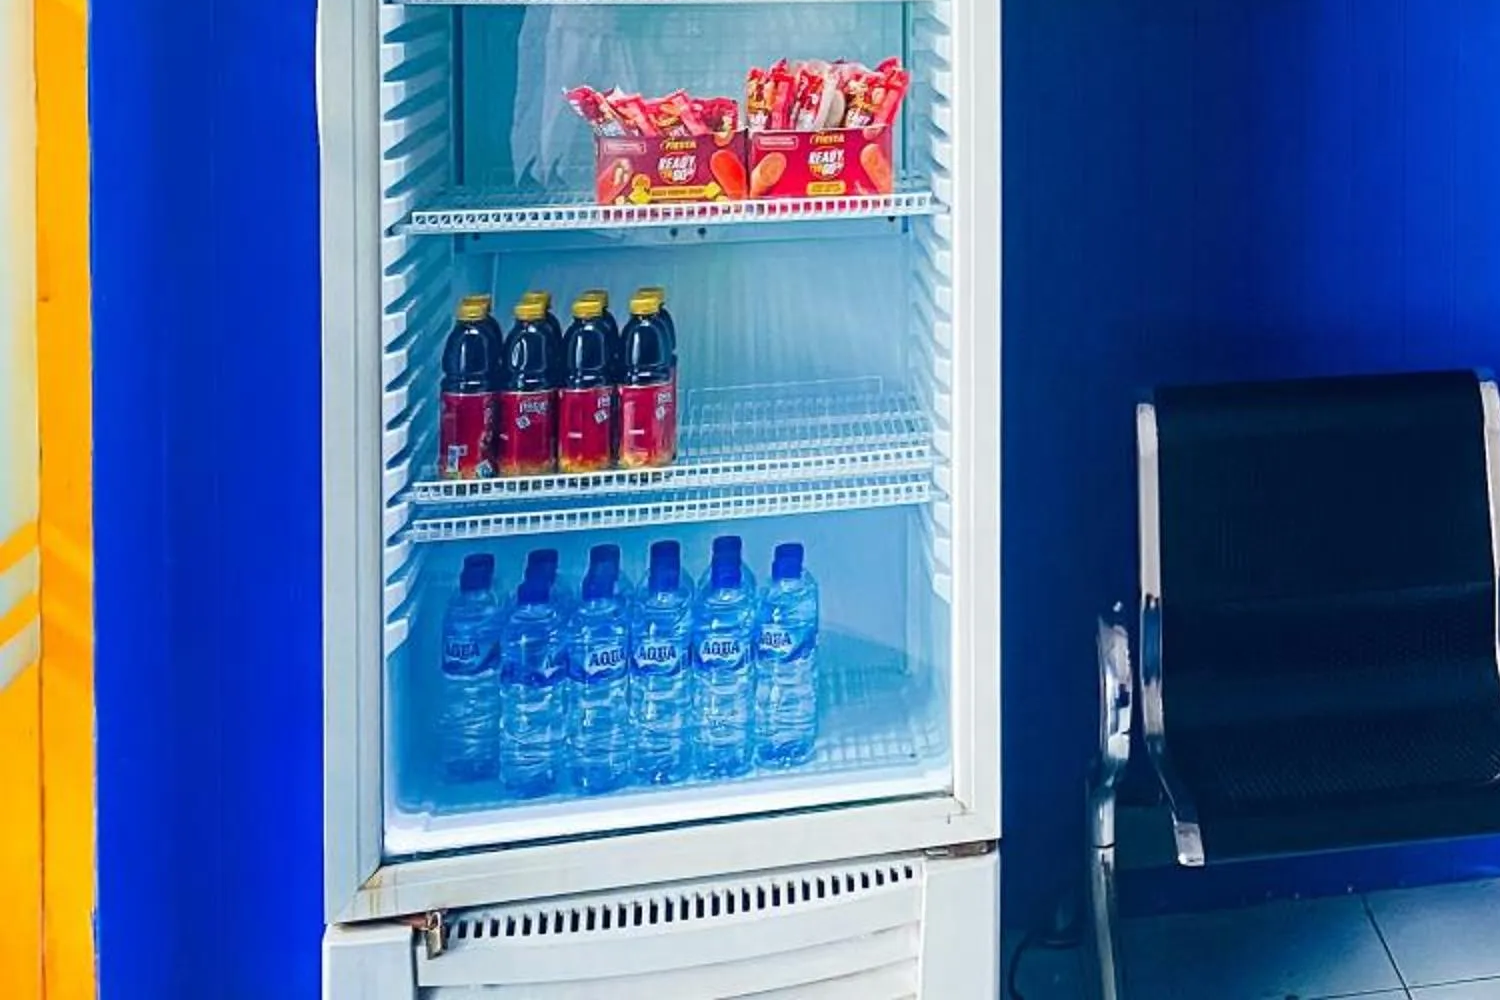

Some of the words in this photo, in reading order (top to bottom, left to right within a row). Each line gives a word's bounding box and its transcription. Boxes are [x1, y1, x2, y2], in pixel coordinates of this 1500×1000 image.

[658, 155, 697, 170] READY
[809, 149, 845, 165] READY
[760, 632, 792, 648] AQUA
[638, 645, 677, 661] AQUA
[702, 640, 740, 657] AQUA
